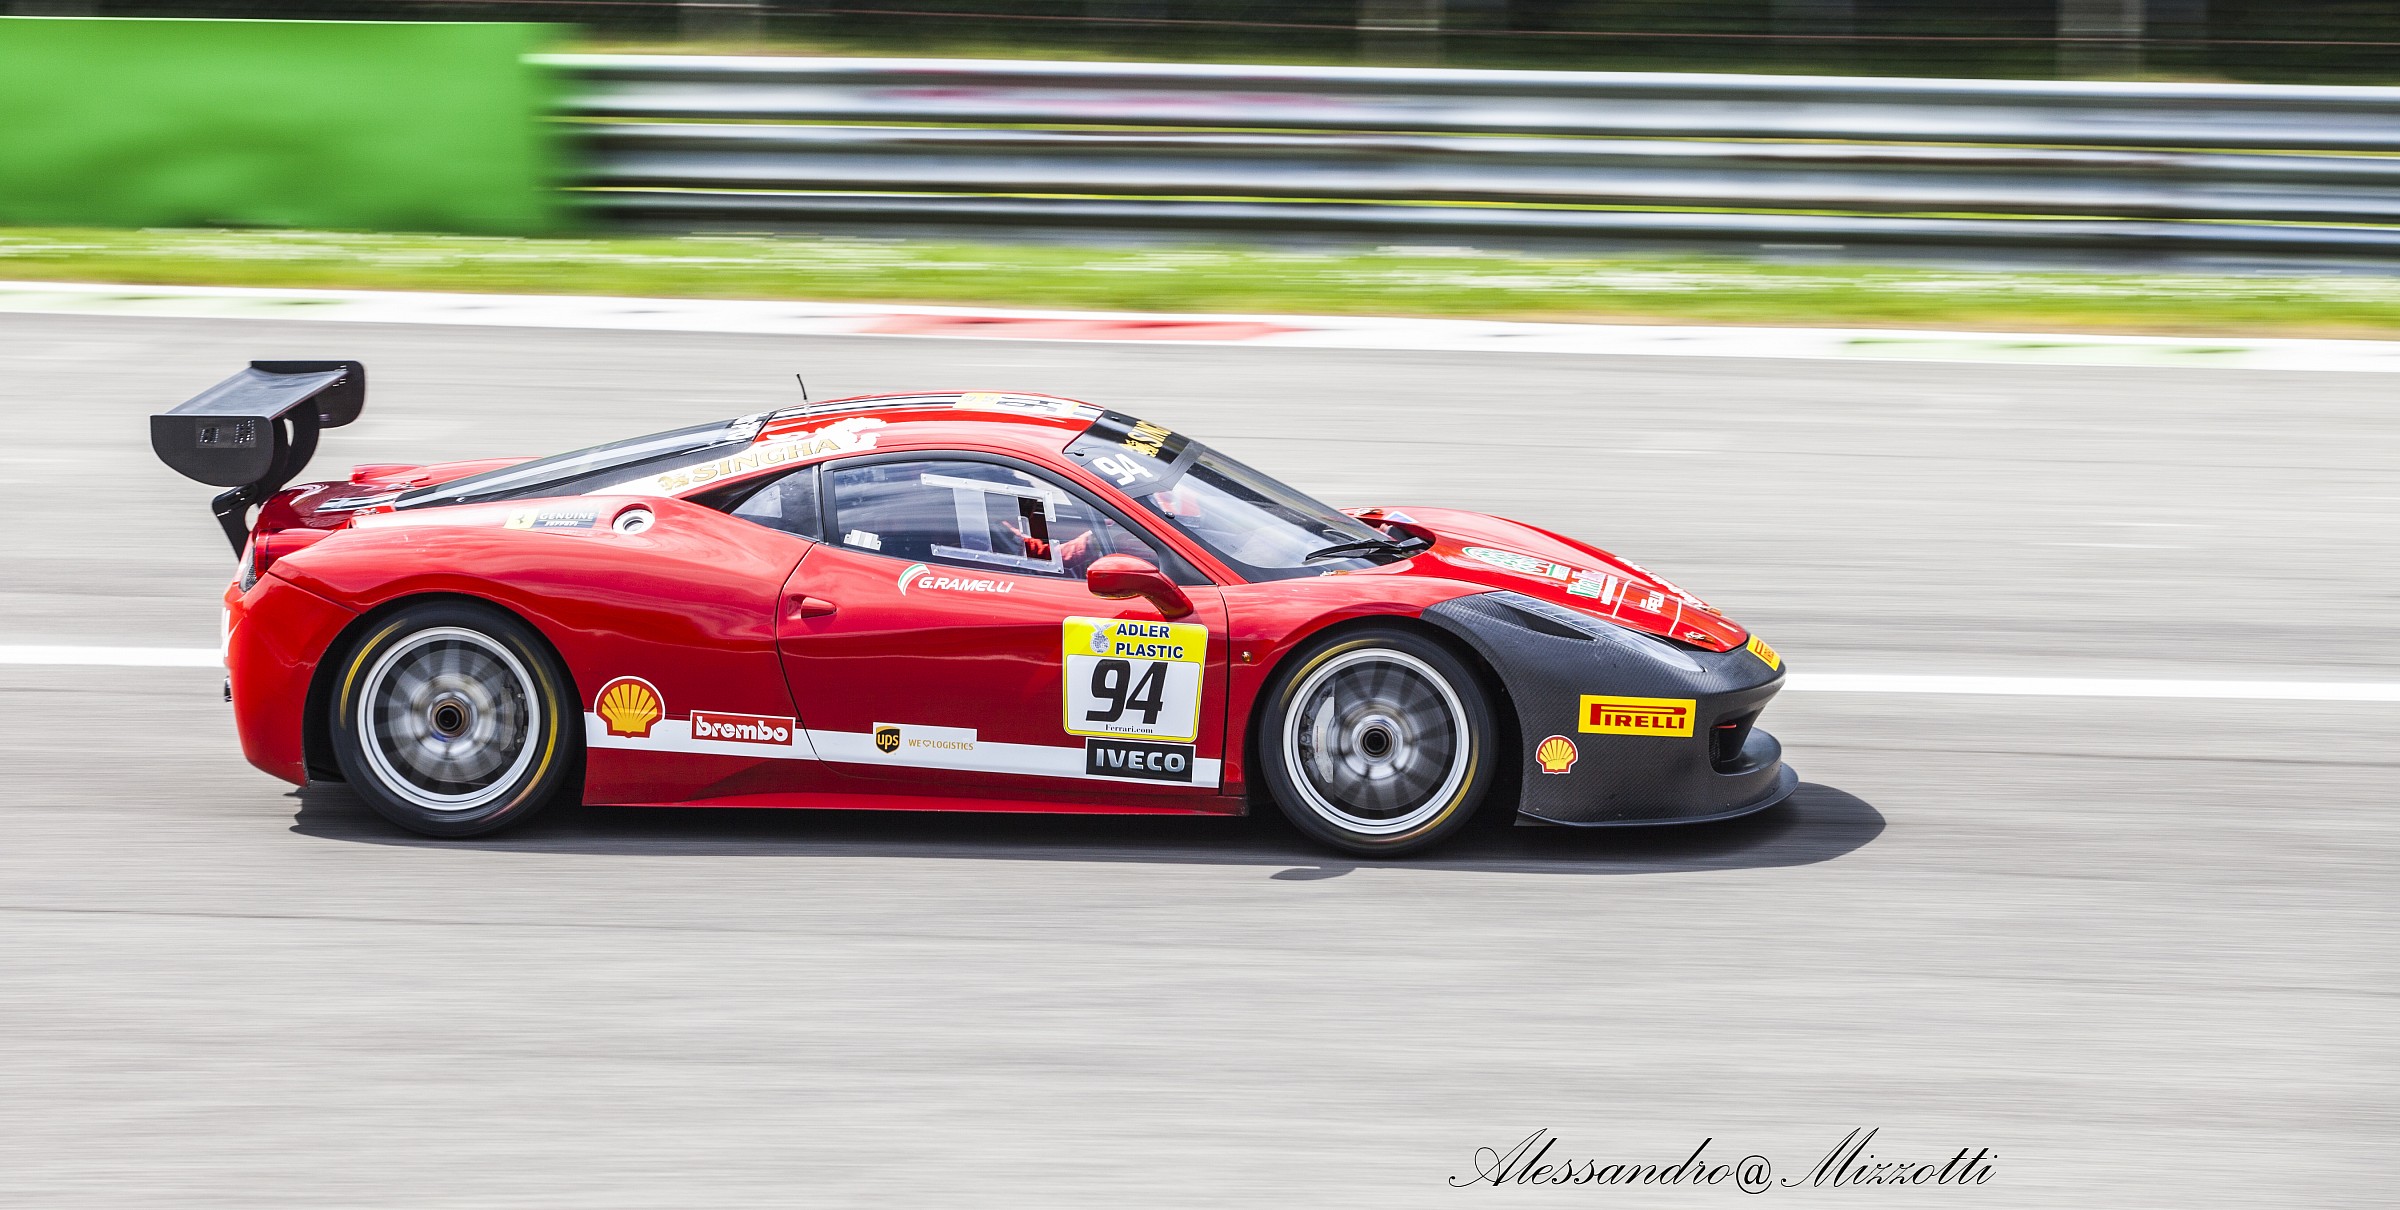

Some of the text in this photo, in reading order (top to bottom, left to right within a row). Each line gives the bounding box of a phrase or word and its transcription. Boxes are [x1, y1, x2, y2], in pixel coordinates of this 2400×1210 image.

[692, 438, 841, 483] SINGHA
[1092, 453, 1153, 486] 94
[540, 512, 595, 520] GENUINE
[918, 576, 1015, 593] G.RAMELLI
[1116, 623, 1170, 639] ADLER
[1115, 642, 1184, 659] PLASTIC
[1085, 658, 1169, 725] 94
[1590, 703, 1687, 729] PIRELLI
[695, 715, 789, 742] brembo
[1105, 723, 1154, 734] Ferrari.com
[877, 733, 899, 750] ups
[908, 738, 974, 751] WE LOGISTICS
[1095, 748, 1187, 773] IVECO
